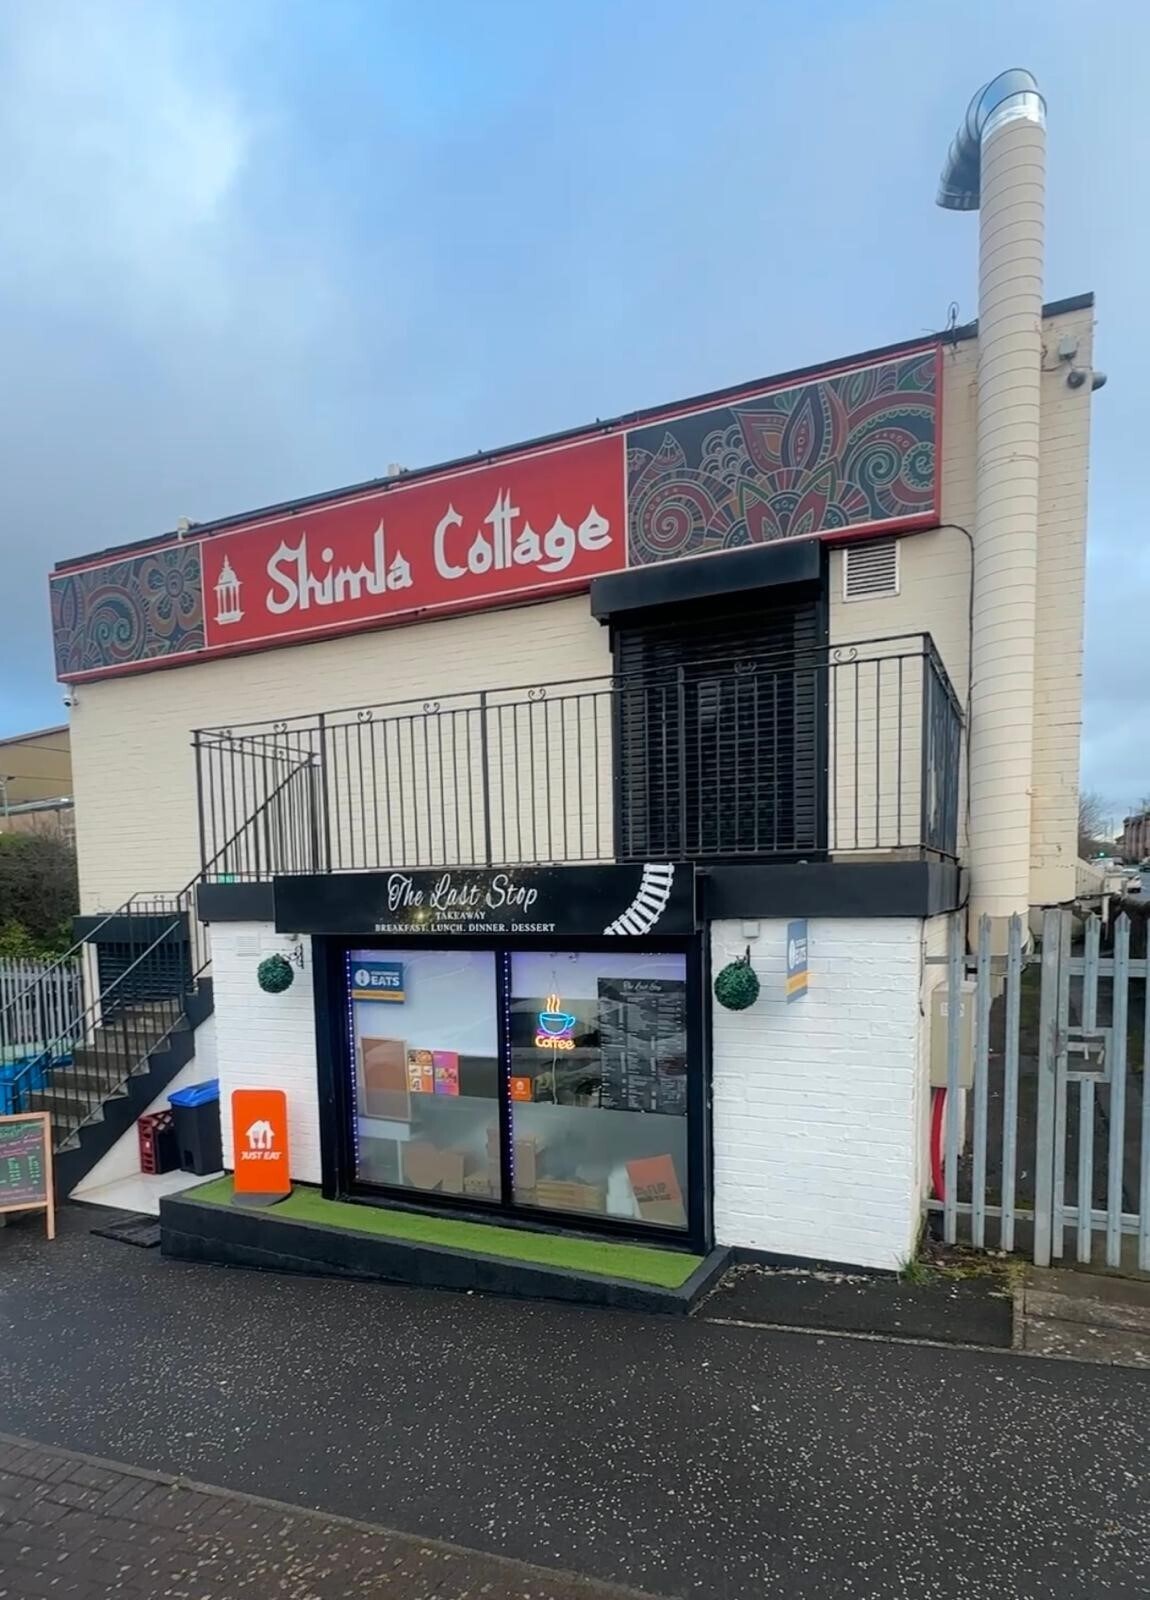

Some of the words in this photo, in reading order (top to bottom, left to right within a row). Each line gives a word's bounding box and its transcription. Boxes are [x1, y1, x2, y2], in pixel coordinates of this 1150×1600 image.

[266, 517, 413, 615] Shimla
[433, 487, 613, 580] Cottage
[387, 873, 424, 911] The
[430, 873, 480, 911] Last
[486, 874, 538, 913] Stop
[435, 911, 486, 920] TAKEAWAY
[511, 923, 556, 932] DESSERT
[371, 975, 400, 987] EATS
[535, 1035, 576, 1050] Coffee
[241, 1151, 263, 1161] JUST
[262, 1151, 282, 1161] EAT
